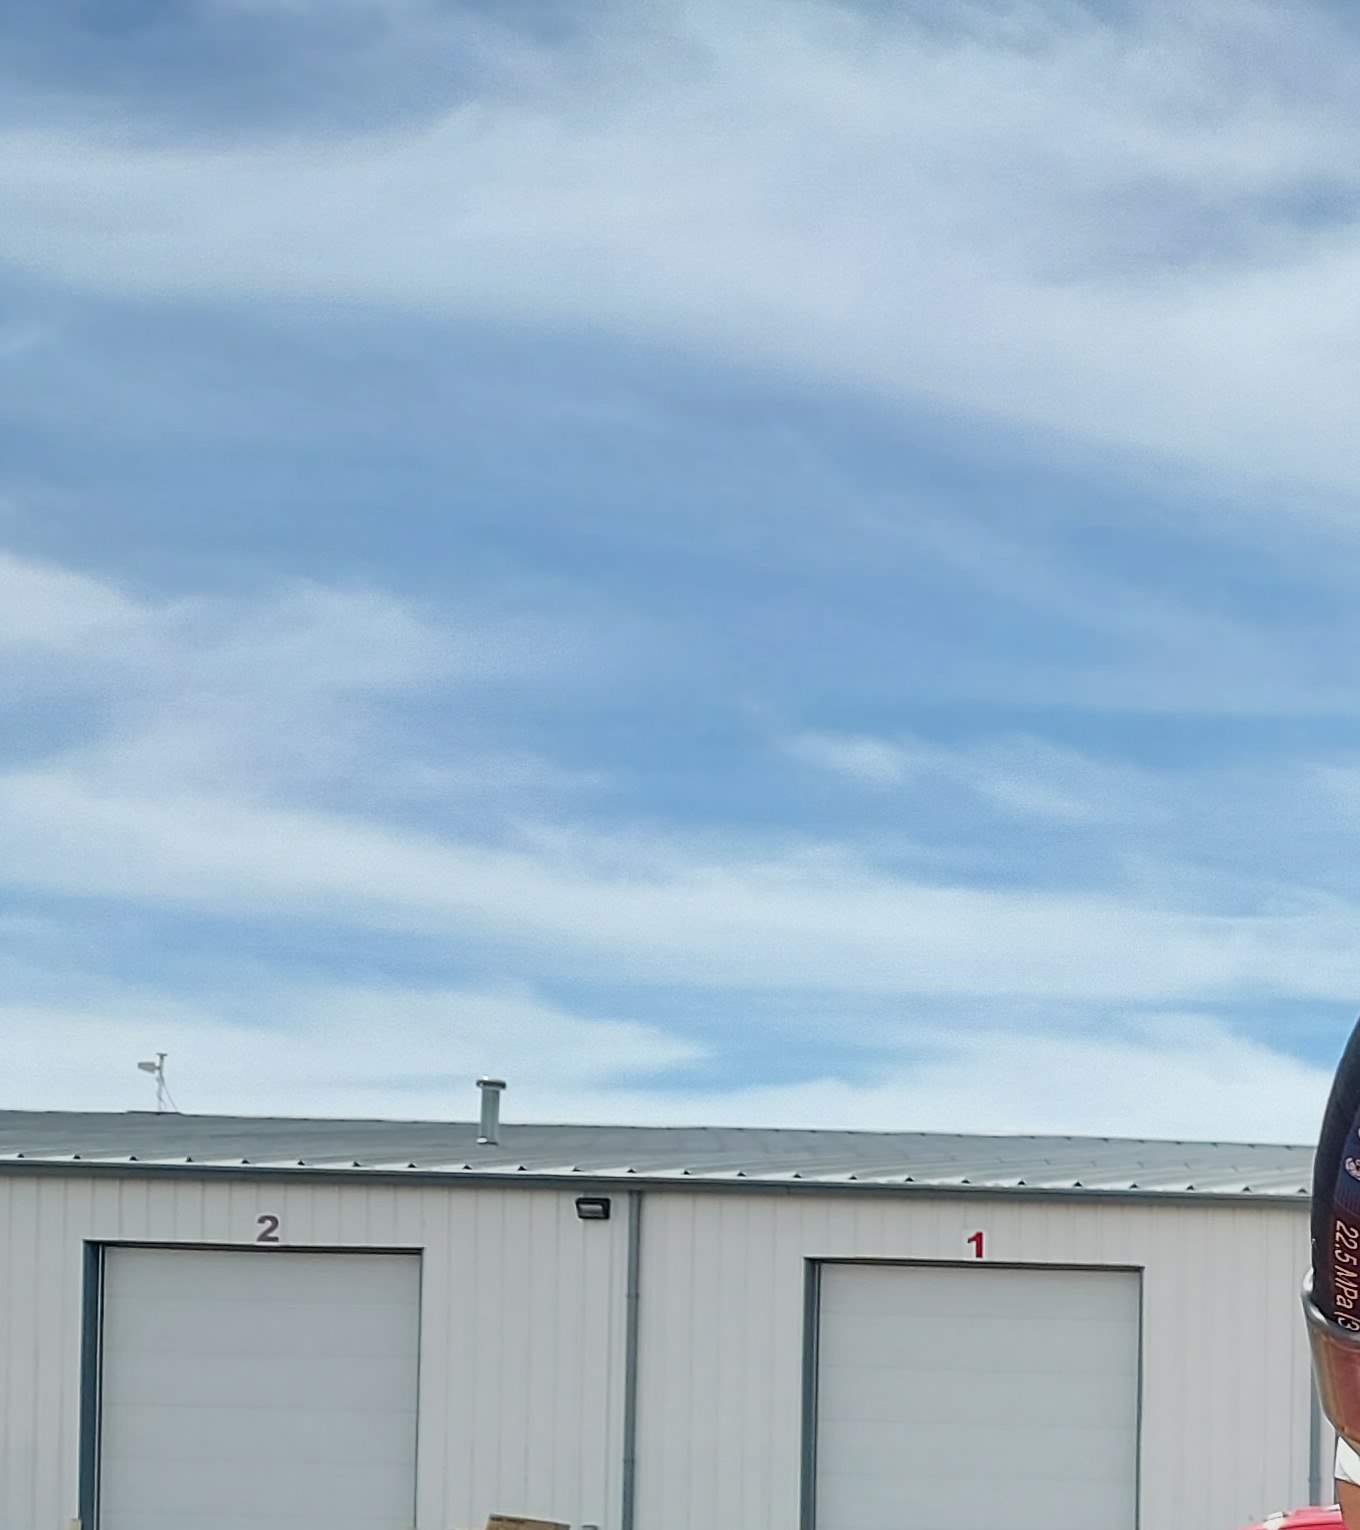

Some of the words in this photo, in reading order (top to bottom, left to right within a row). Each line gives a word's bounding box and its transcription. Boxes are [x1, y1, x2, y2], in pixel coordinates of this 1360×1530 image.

[256, 1214, 279, 1243] 2
[967, 1231, 983, 1258] 1
[1334, 1220, 1359, 1267] 22.5
